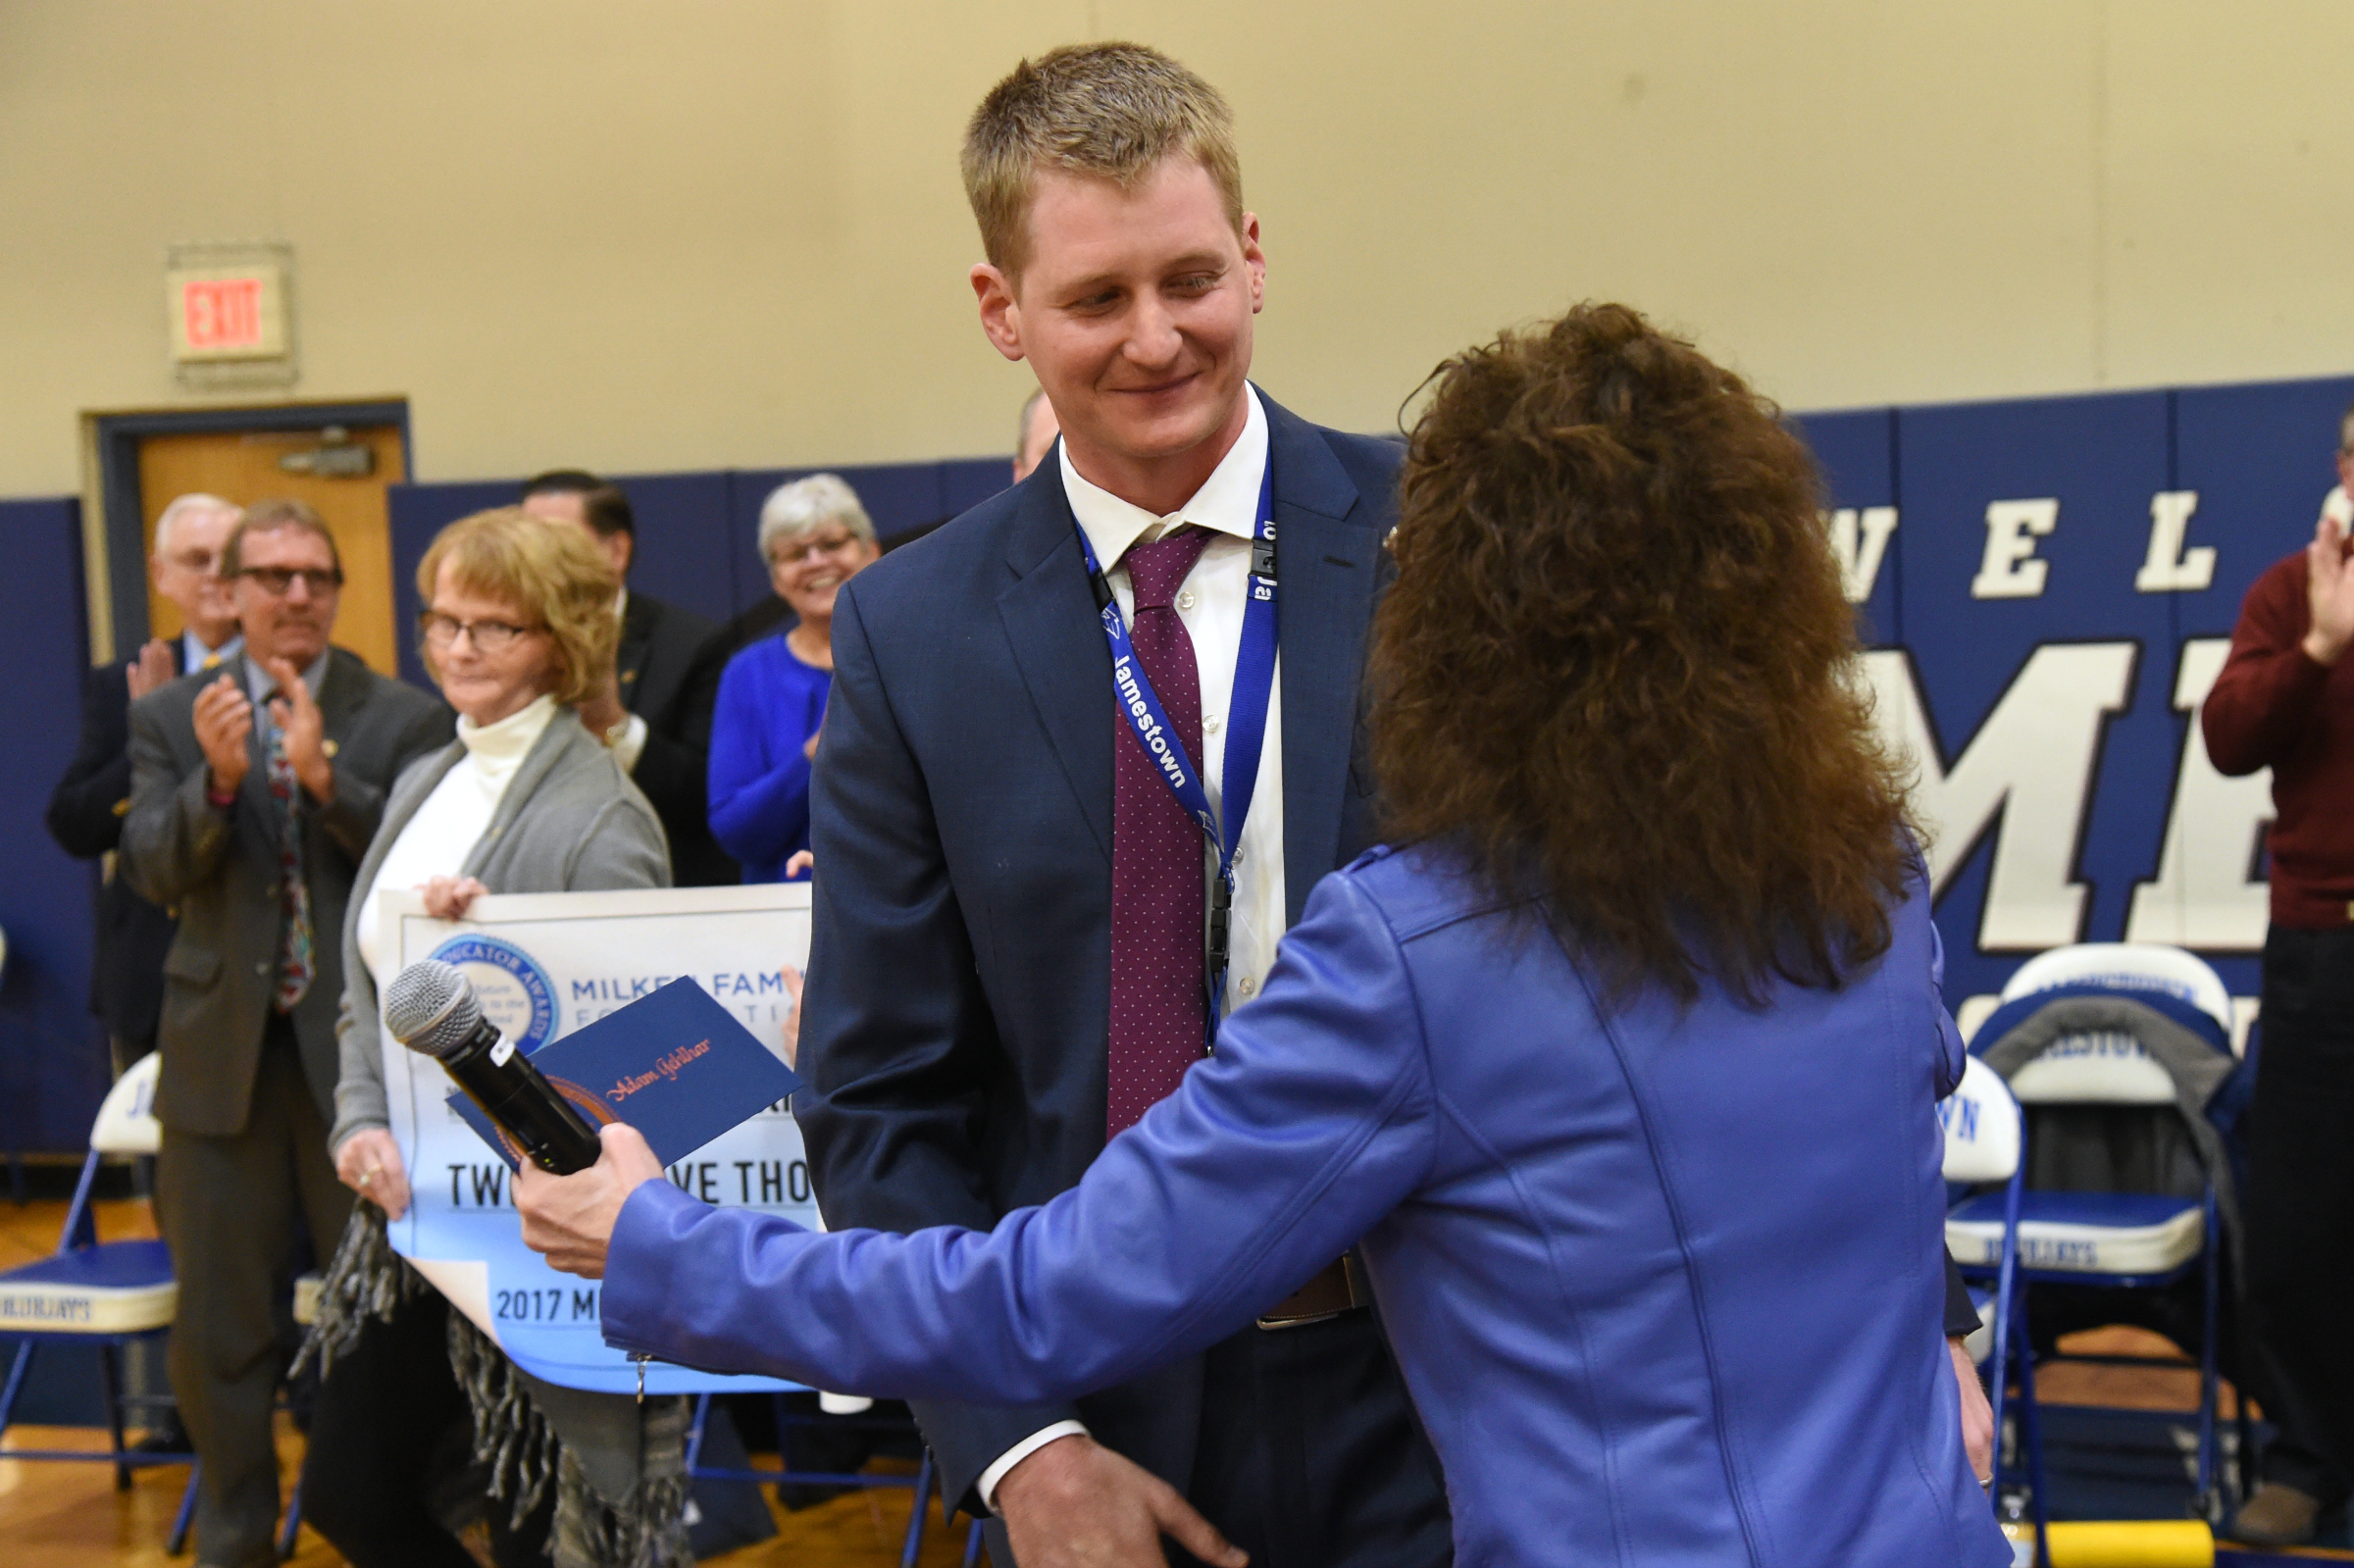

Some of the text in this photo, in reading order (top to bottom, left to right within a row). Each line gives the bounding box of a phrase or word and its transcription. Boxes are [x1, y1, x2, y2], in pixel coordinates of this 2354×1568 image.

[182, 278, 263, 349] EXIT
[1114, 654, 1187, 788] Jamestown
[572, 976, 695, 1000] MILKE
[605, 1070, 660, 1102] Adam
[496, 1288, 562, 1322] 2017
